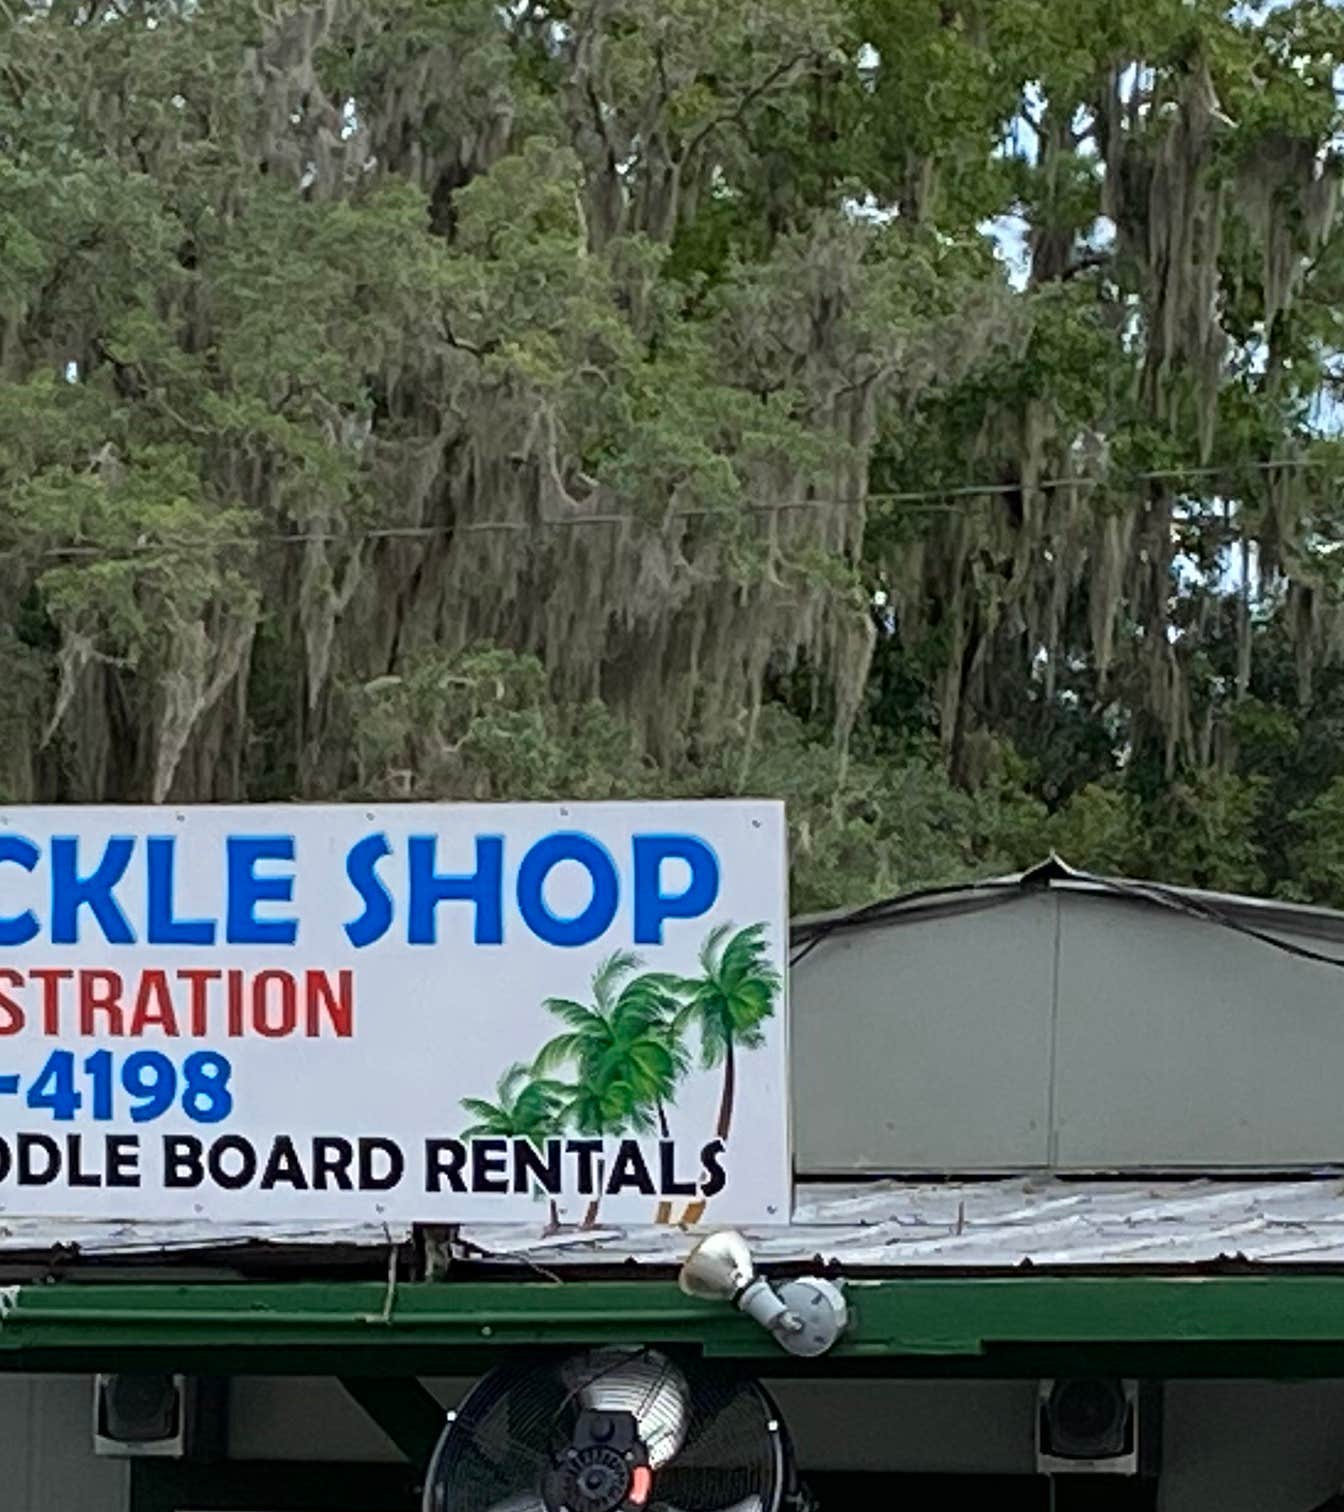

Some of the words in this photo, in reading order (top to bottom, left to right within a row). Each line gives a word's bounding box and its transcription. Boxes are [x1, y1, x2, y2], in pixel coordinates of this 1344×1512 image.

[341, 829, 722, 948] SHOP
[163, 1134, 404, 1191] BOARD
[425, 1137, 727, 1197] RENTALS
